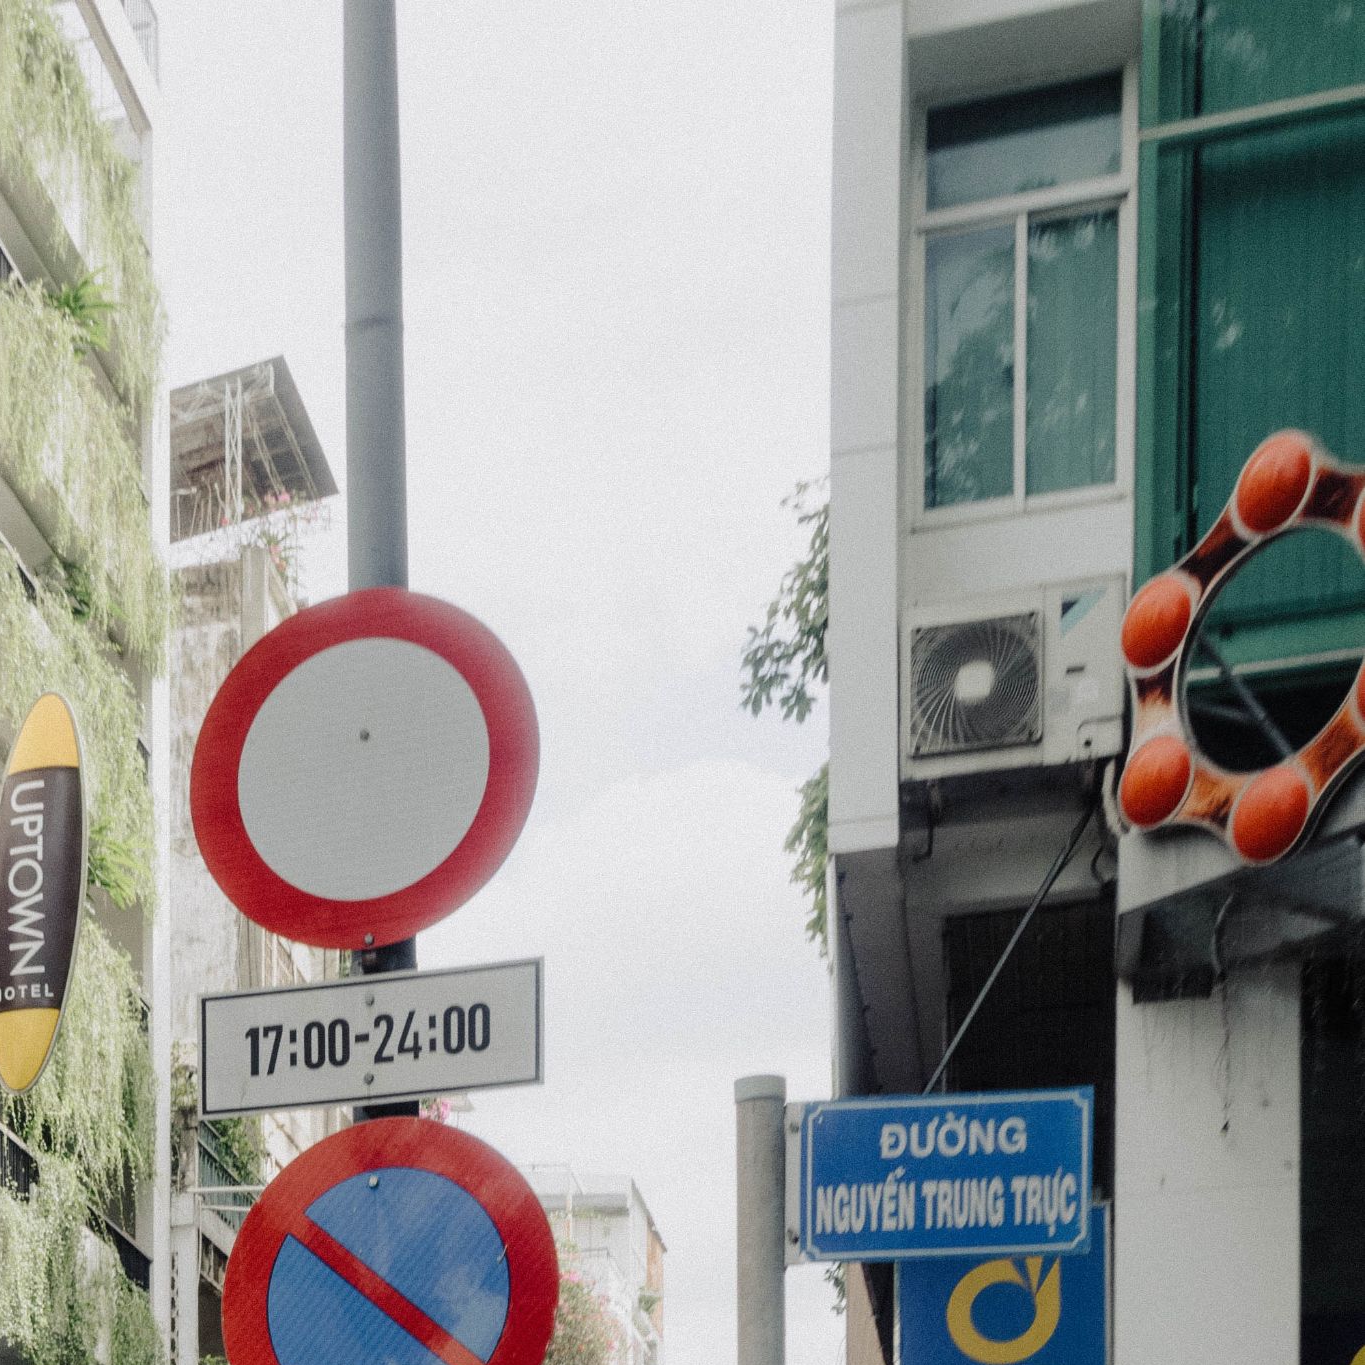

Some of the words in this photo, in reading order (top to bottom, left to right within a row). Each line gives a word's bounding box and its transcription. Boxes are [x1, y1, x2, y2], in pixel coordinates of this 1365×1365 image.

[8, 779, 45, 976] UPTOWN
[245, 1003, 491, 1076] 17:00-24:00
[880, 1112, 1027, 1159] ĐƯỜNG
[921, 1175, 1005, 1229] TRUNG
[1011, 1166, 1077, 1237] TRỰC
